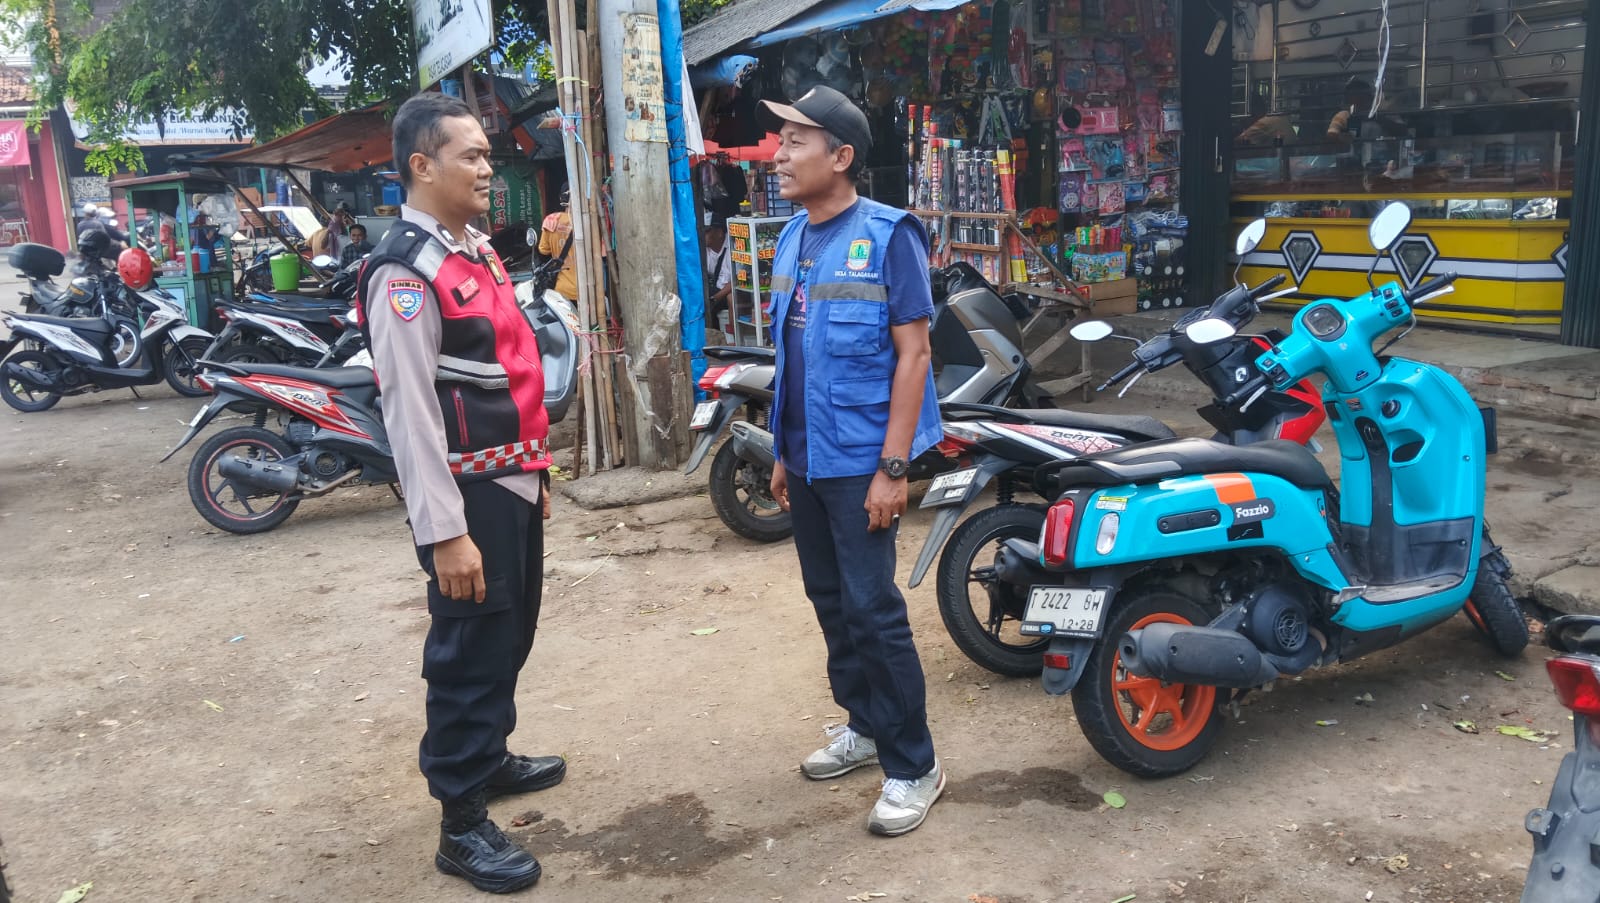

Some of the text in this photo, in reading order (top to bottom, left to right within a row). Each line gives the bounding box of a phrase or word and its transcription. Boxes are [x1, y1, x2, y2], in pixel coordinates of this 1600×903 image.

[391, 282, 422, 290] BINMAS
[1235, 504, 1269, 519] Fazzio
[1031, 592, 1038, 609] T
[1041, 592, 1072, 610] 2422
